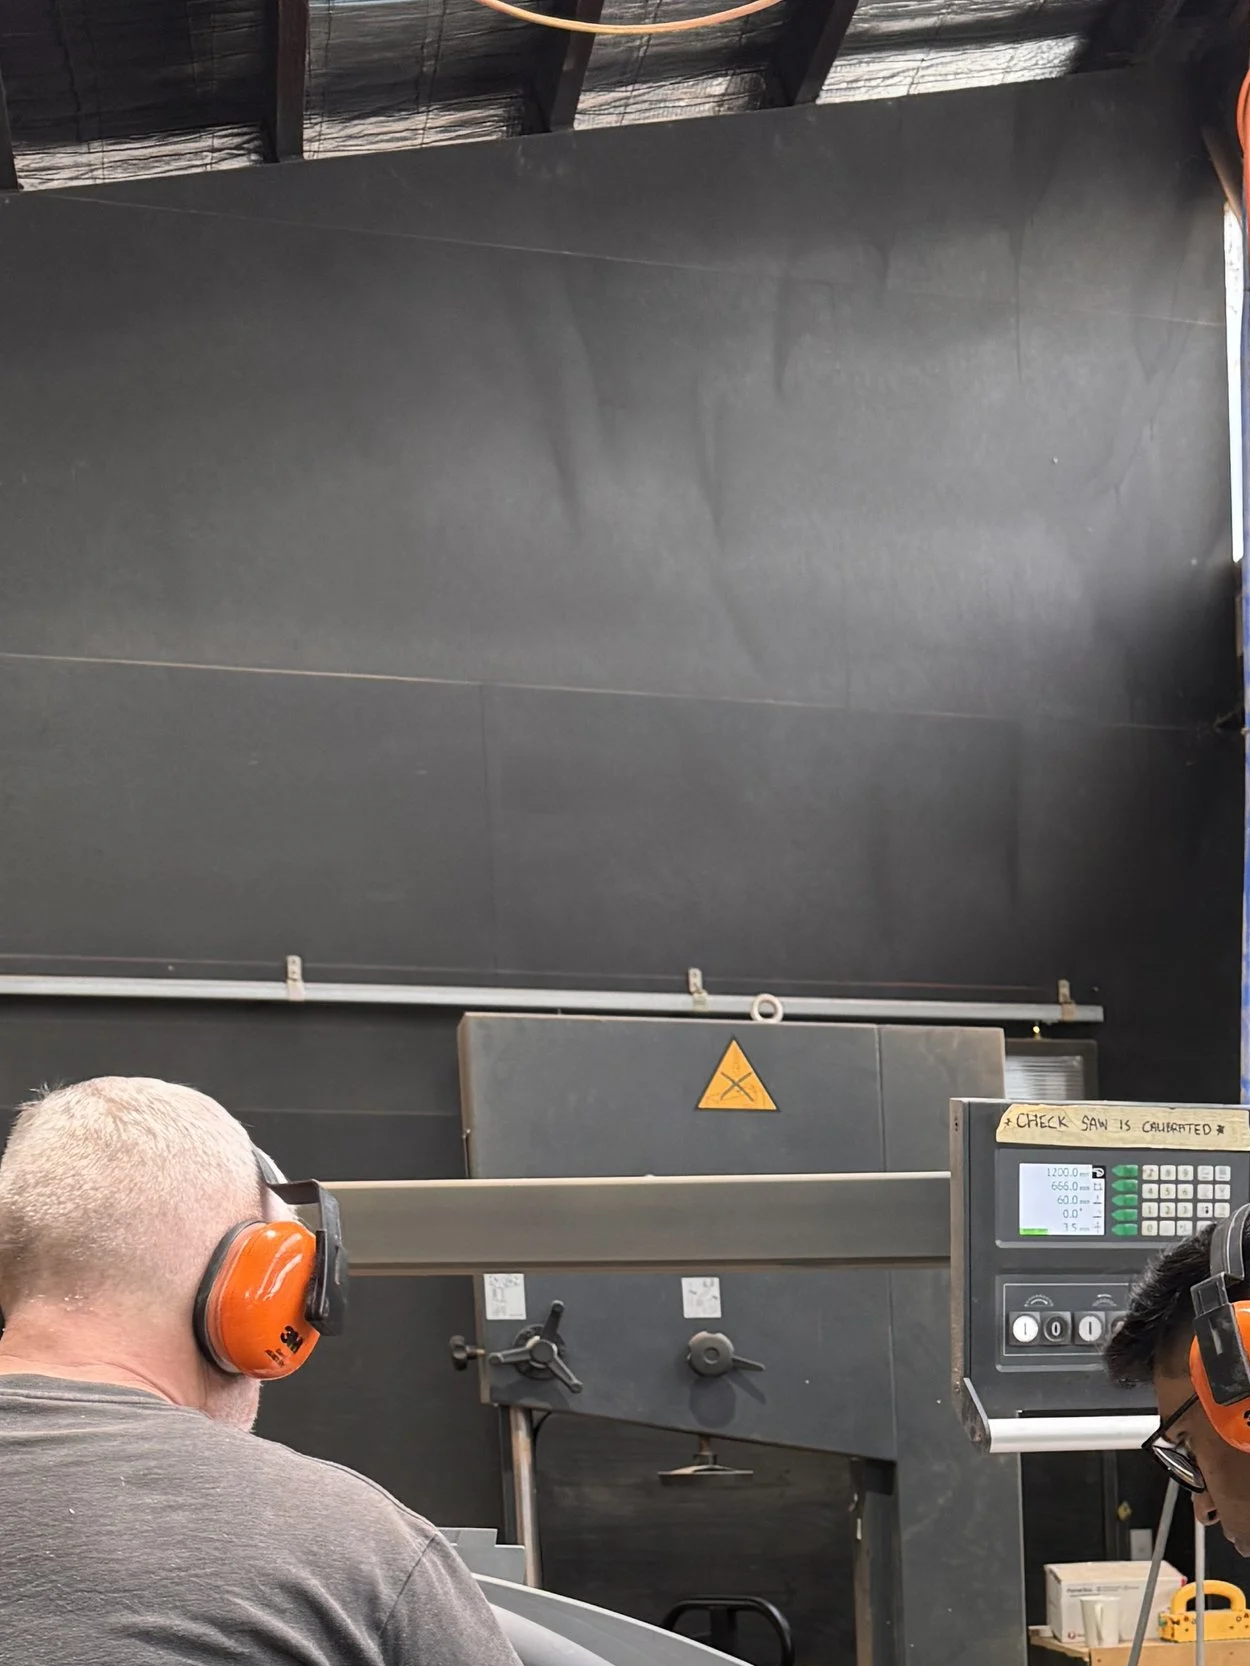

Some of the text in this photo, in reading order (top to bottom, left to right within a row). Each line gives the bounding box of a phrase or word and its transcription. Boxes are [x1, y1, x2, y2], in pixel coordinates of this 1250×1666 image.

[1016, 1112, 1212, 1136] CHECK SAW IS CALIBRATED
[280, 1325, 304, 1355] 3M
